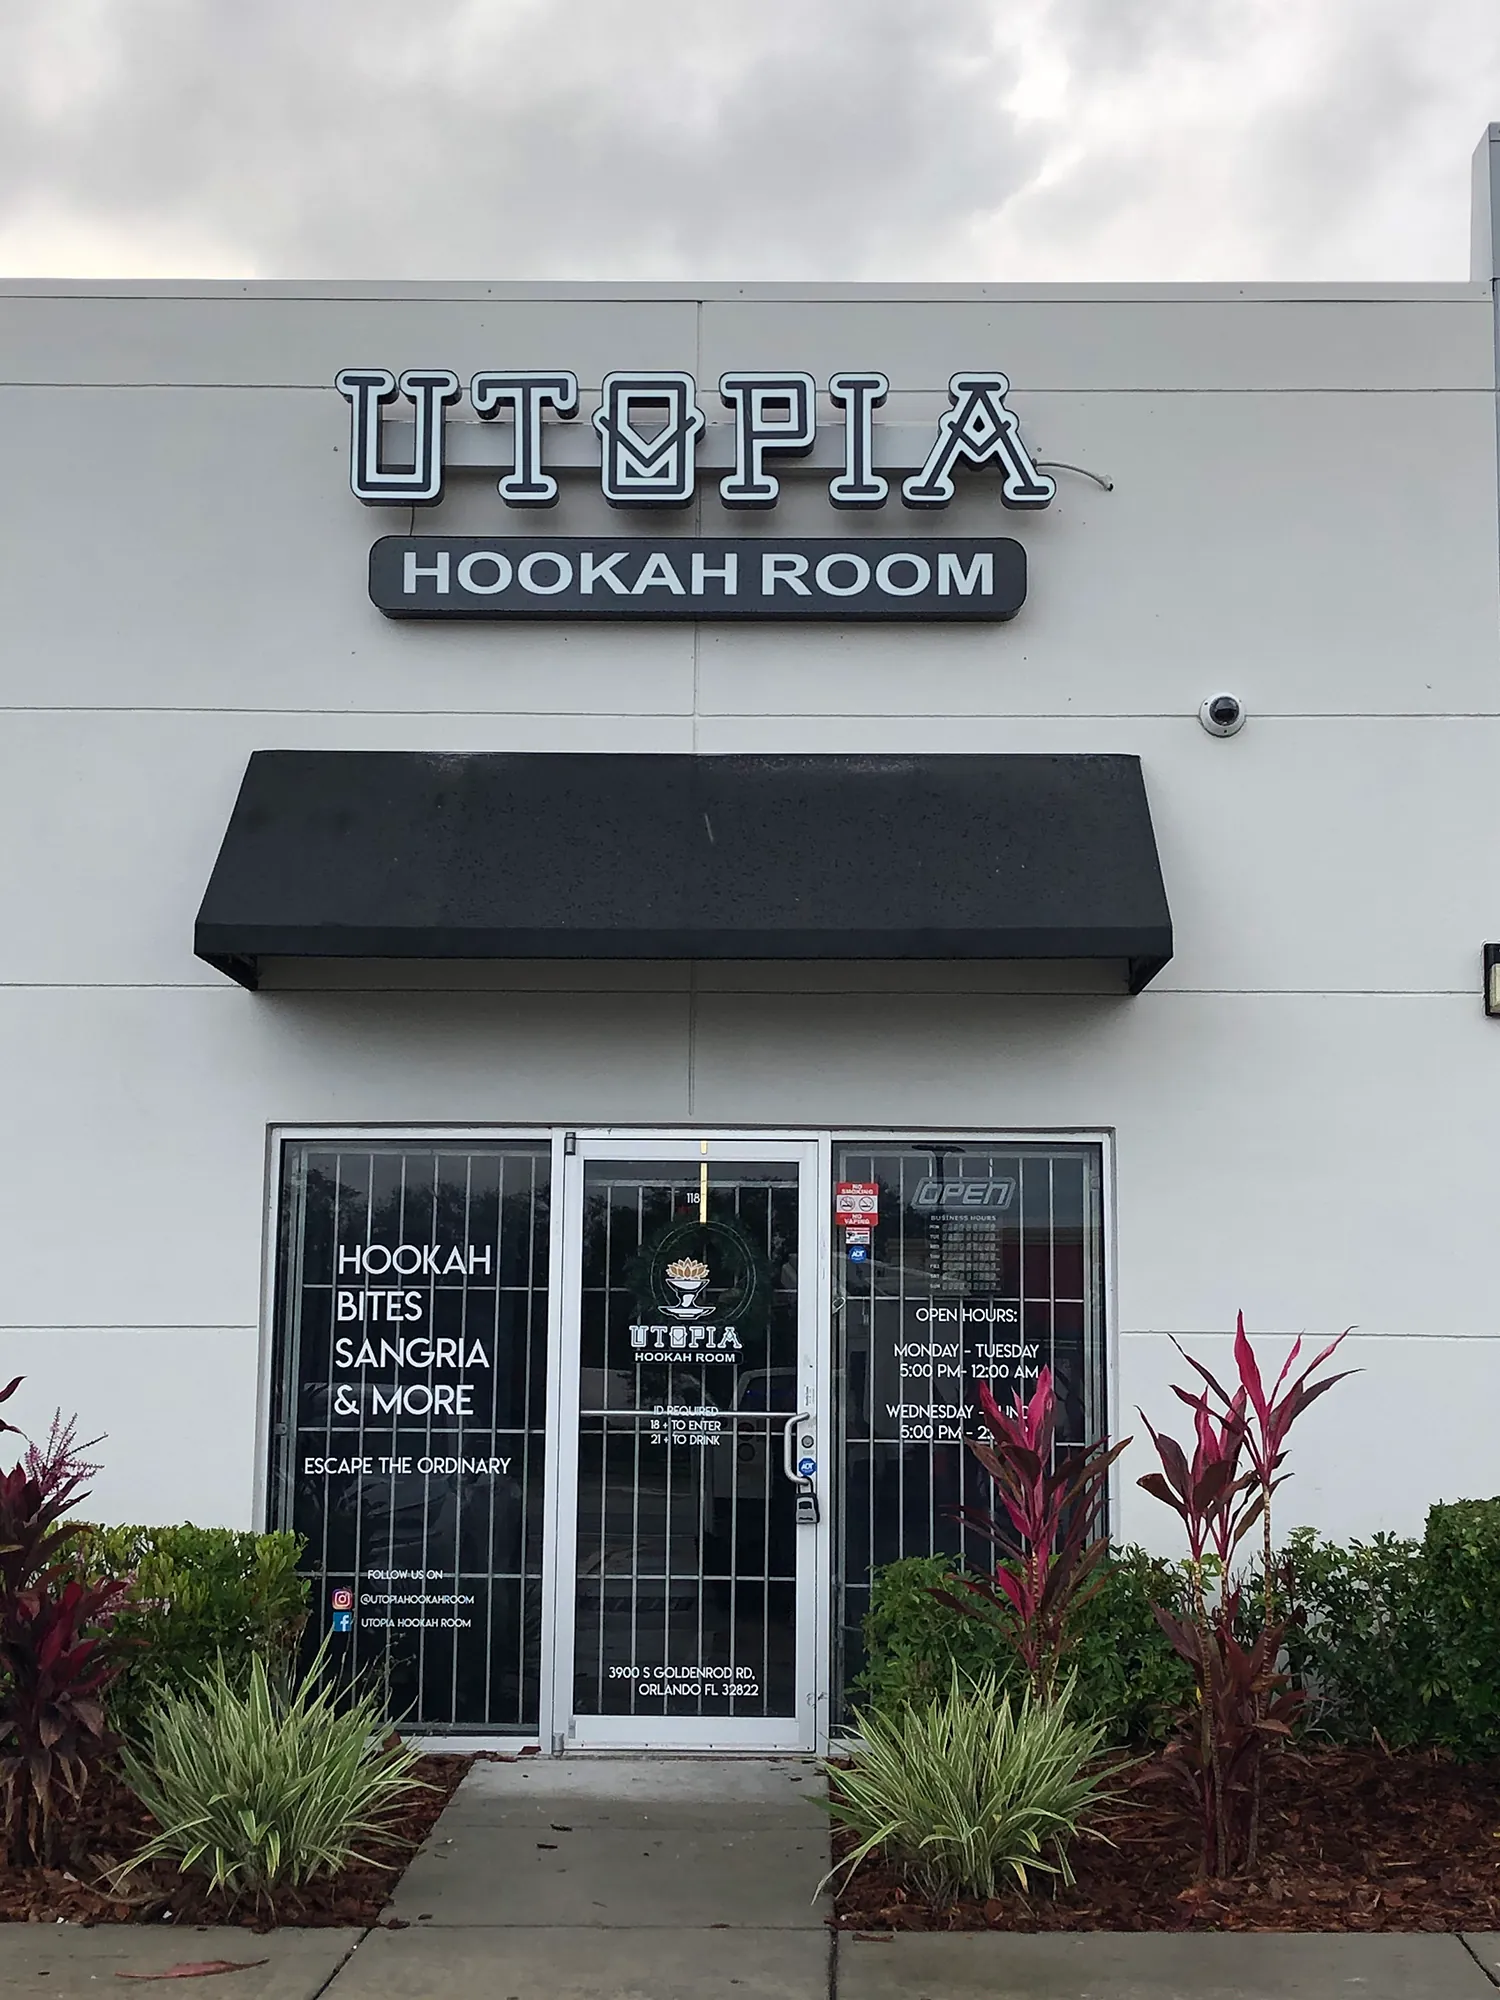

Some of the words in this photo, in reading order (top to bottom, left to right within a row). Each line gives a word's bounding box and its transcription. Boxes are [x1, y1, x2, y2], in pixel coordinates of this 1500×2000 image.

[335, 369, 1057, 506] UTOPIA
[402, 551, 738, 596] HOOKAH
[761, 551, 994, 597] ROOM
[686, 1192, 701, 1204] 118
[918, 1183, 1009, 1205] OPEN
[338, 1244, 491, 1275] HOOKAH
[337, 1291, 423, 1322] BITES
[915, 1308, 958, 1322] OPEN
[962, 1308, 1018, 1323] HOURS:
[628, 1325, 743, 1349] UTOPIA
[335, 1337, 490, 1368] SANGRIA
[634, 1352, 692, 1362] HOOKAH
[695, 1353, 736, 1363] ROOM
[894, 1343, 960, 1358] MONDAY
[975, 1343, 1040, 1358] TUESDAY
[900, 1363, 933, 1378] 5:00
[971, 1364, 1010, 1378] 12:00
[1014, 1365, 1040, 1378] AM
[334, 1384, 360, 1415] &
[372, 1384, 475, 1416] MORE
[653, 1405, 665, 1416] ID
[666, 1405, 719, 1416] REQUIRED
[886, 1403, 975, 1419] WEDNESDAY
[650, 1419, 660, 1430] 18
[671, 1420, 686, 1430] TO
[688, 1420, 722, 1431] ENTER
[900, 1424, 934, 1439] 5:00
[938, 1425, 962, 1439] PM
[650, 1434, 661, 1444] 21
[672, 1434, 687, 1445] TO
[689, 1435, 720, 1445] DRINK
[304, 1457, 373, 1475] ESCAPE
[378, 1457, 412, 1475] THE
[417, 1457, 512, 1475] ORDINARY
[367, 1569, 409, 1580] FOLLOW
[411, 1569, 425, 1580] US
[426, 1569, 444, 1580] ON
[359, 1593, 475, 1605] @UTOPIAHOOKAHROOM
[361, 1618, 395, 1628] UTOPIA
[397, 1618, 439, 1628] HOOKAH
[440, 1618, 472, 1628] ROOM
[608, 1666, 640, 1679] 3900
[643, 1666, 651, 1679] S
[653, 1666, 733, 1679] GOLDENROD
[638, 1683, 701, 1696] ORLANDO
[704, 1684, 719, 1696] FL
[721, 1684, 760, 1696] 32822
